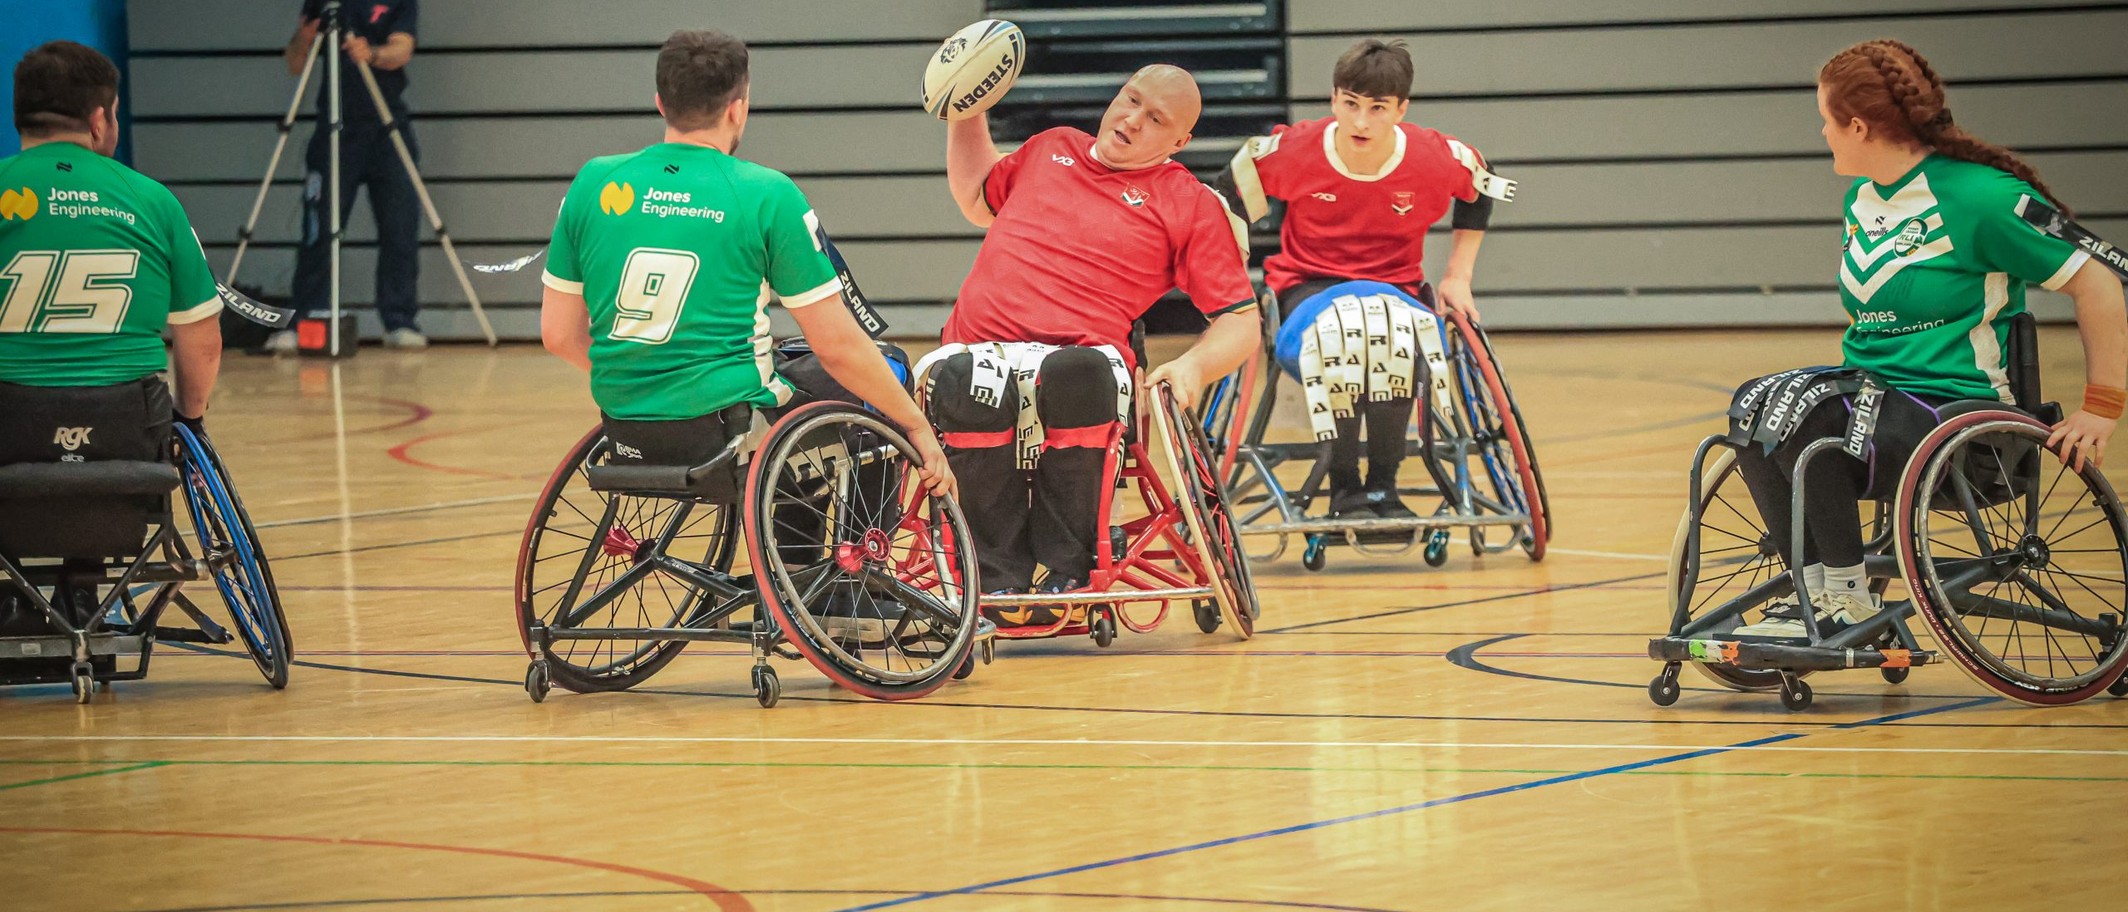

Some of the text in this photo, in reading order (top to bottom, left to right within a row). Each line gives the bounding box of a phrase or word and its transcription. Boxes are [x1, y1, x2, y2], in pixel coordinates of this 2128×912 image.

[953, 54, 1013, 112] STEEDEN
[48, 187, 99, 202] Jones
[49, 203, 136, 225] Engineering
[641, 201, 725, 223] Engineering
[643, 187, 691, 203] Jones
[0, 249, 141, 334] 15
[216, 282, 281, 322] ZILAND
[607, 247, 700, 345] 9
[840, 270, 880, 332] ZILAND
[1856, 309, 1897, 324] Jones
[1766, 373, 1813, 431] ZILAND
[1849, 395, 1875, 455] ZILAND
